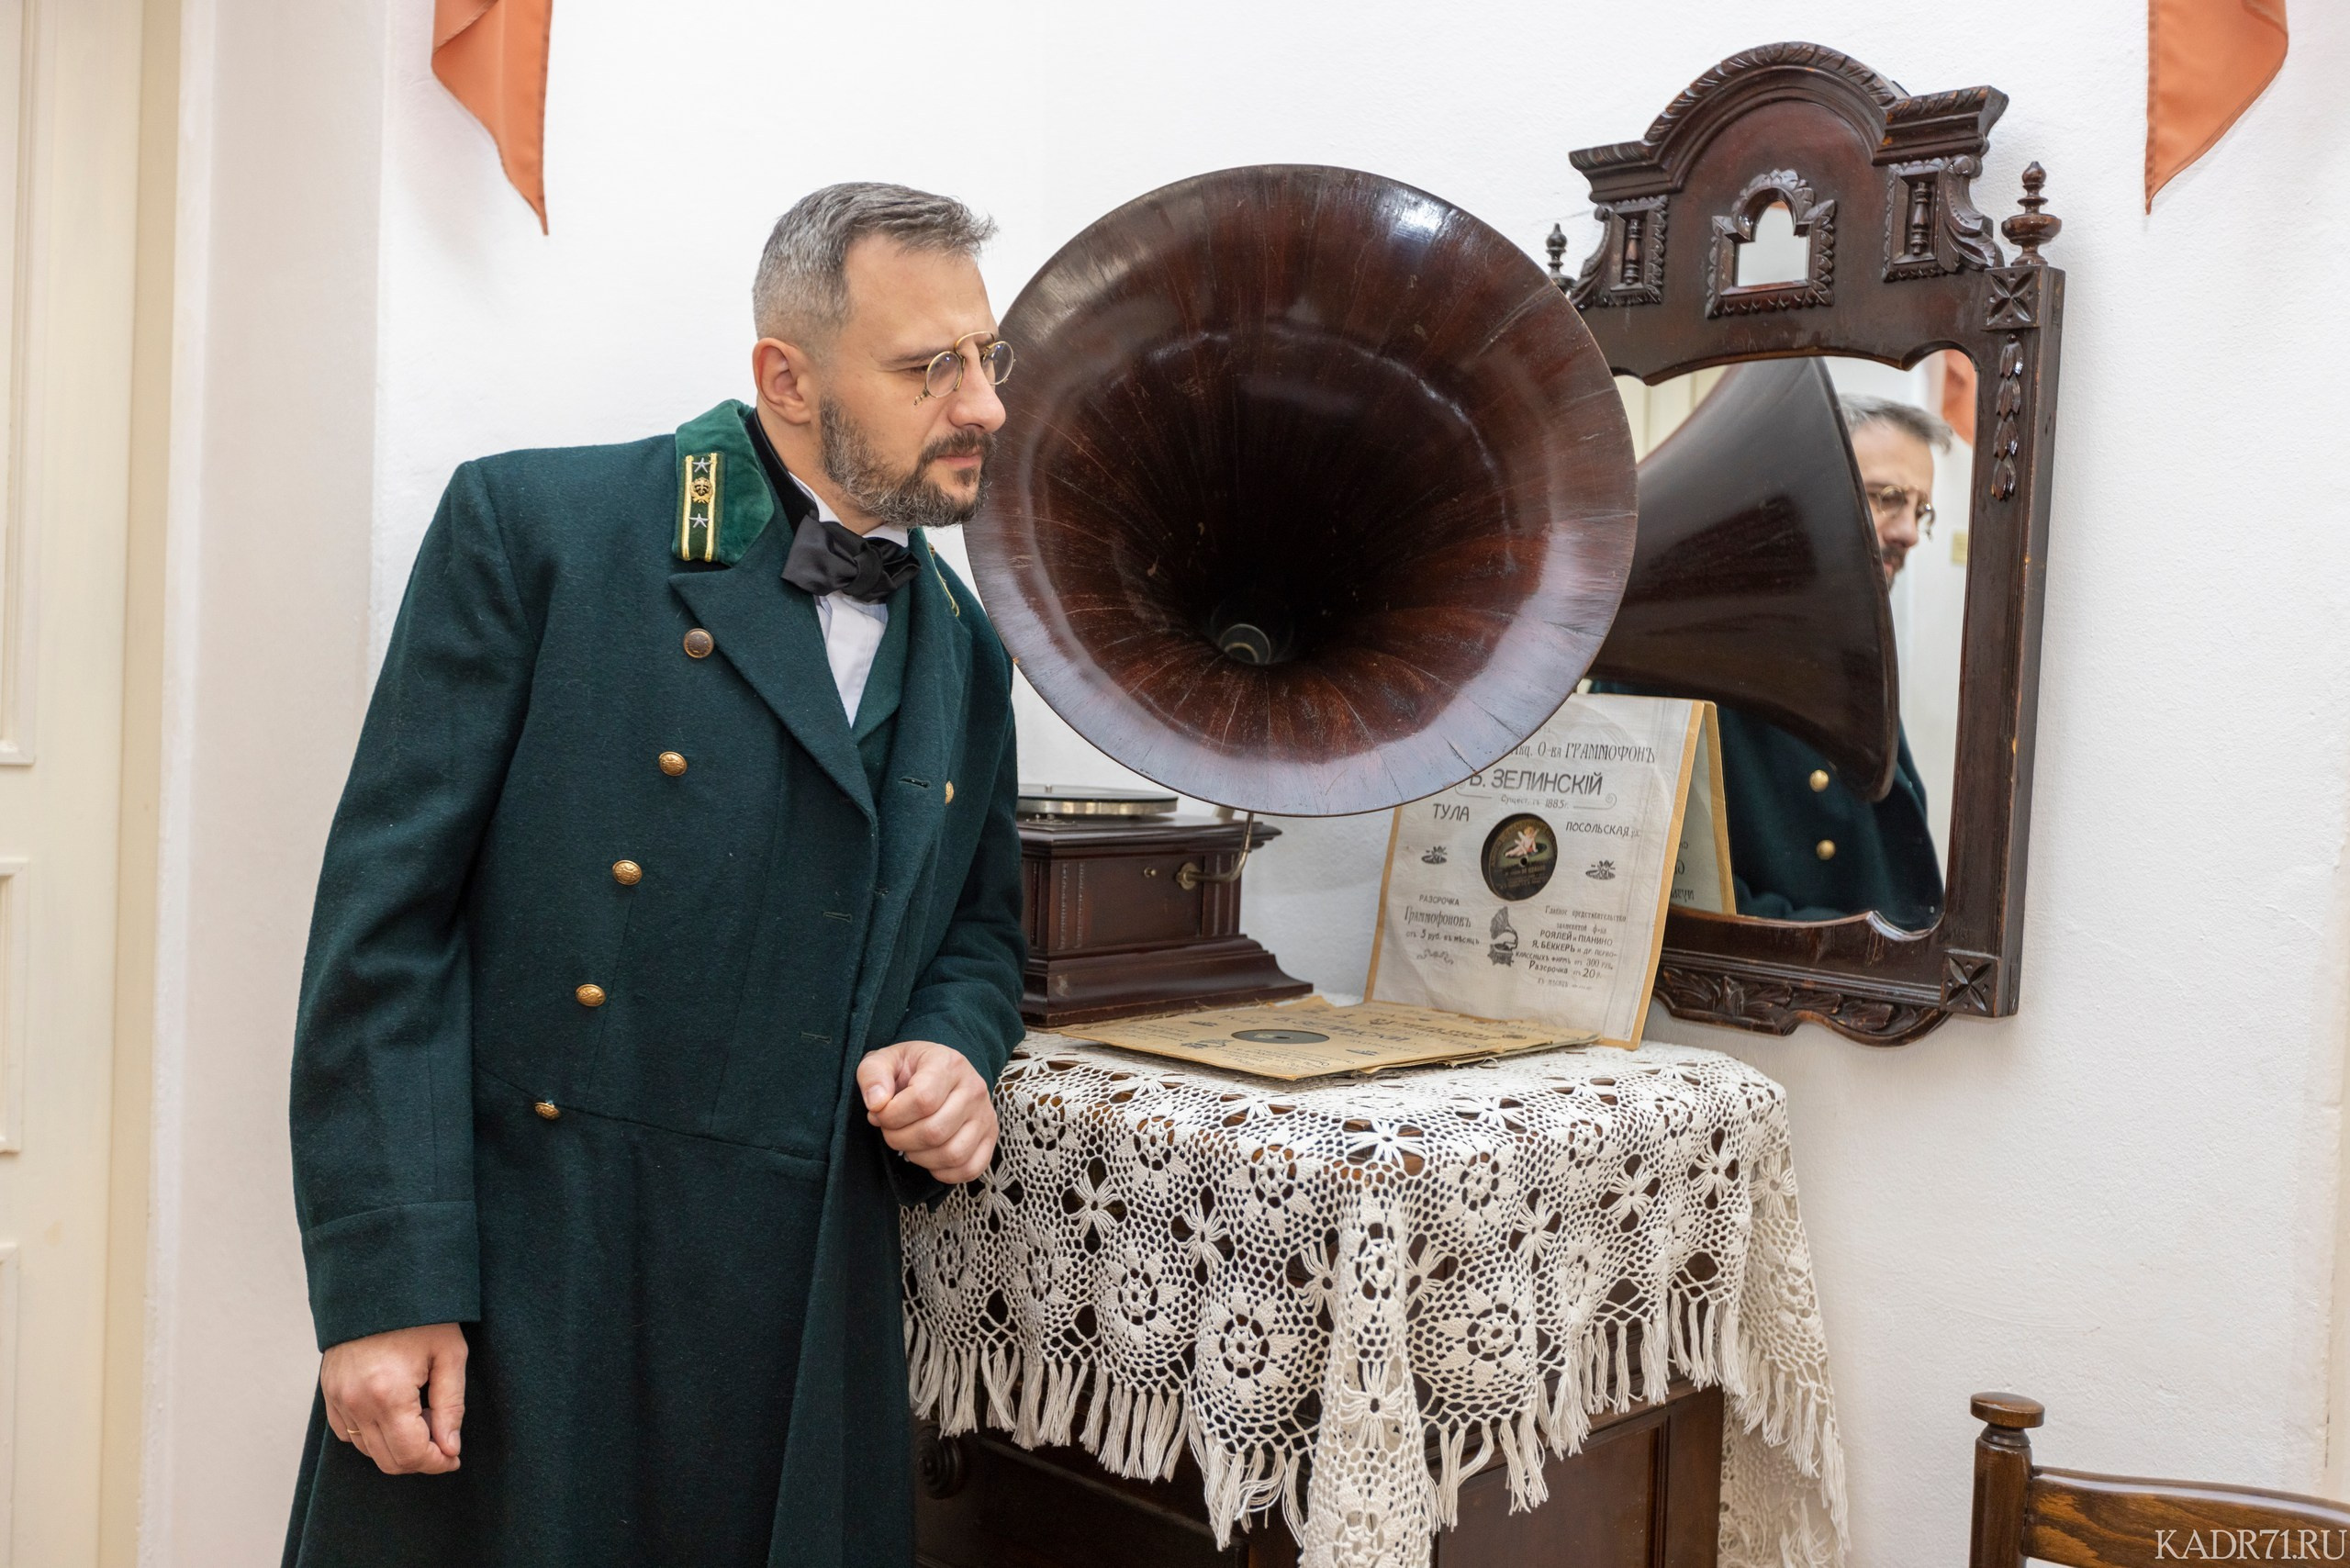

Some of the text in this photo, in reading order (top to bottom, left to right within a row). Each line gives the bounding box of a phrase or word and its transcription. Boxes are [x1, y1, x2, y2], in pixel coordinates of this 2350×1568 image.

[1564, 742, 1655, 763] ГРАММОФОНЪ
[1492, 768, 1603, 795] ЗЕЛИНСКІЙ
[1433, 803, 1470, 822] ТУЛА
[1565, 821, 1630, 836] ПОСОЛЬСКАЯ
[1419, 894, 1460, 906] РАЗСРОЧКА
[1540, 929, 1572, 942] РОЯЛЕЙ
[1578, 935, 1613, 946] ПІАНИНО
[1528, 959, 1568, 974] Разсрочка
[1582, 968, 1595, 979] 20
